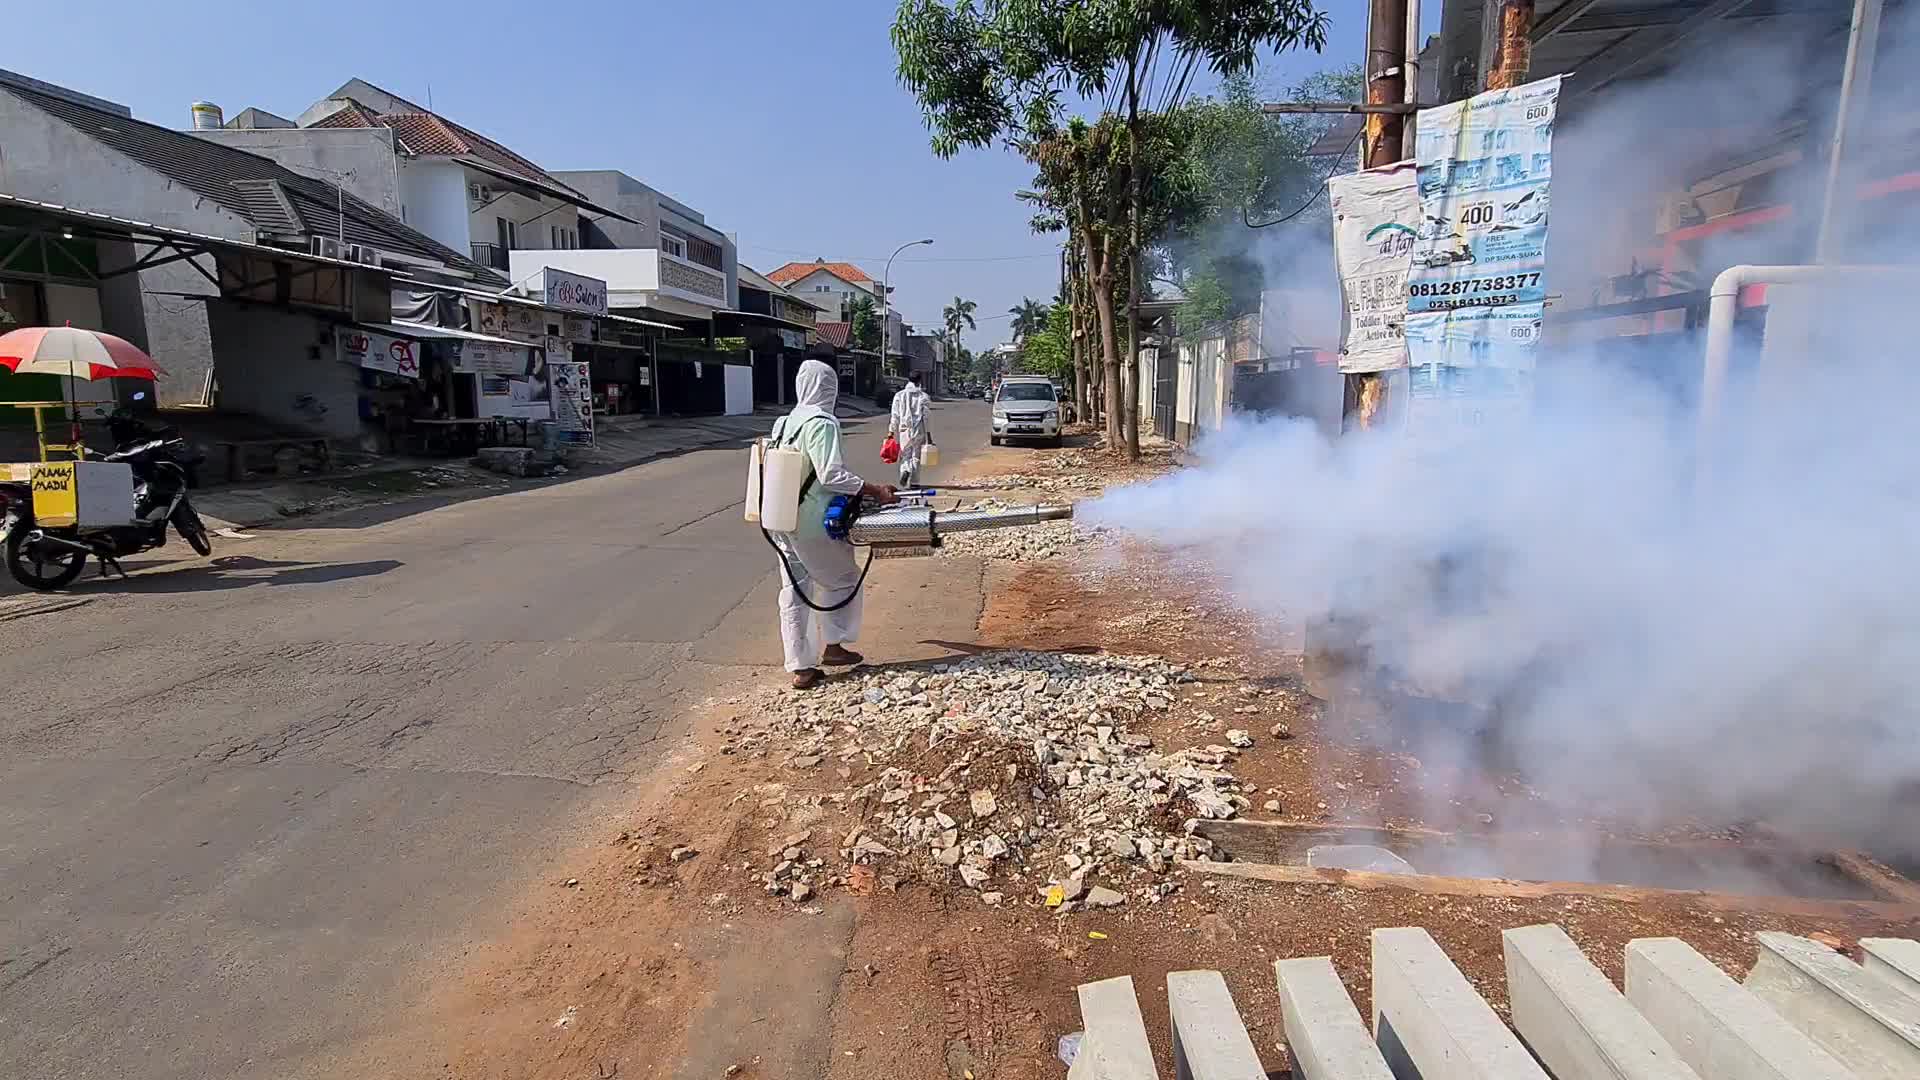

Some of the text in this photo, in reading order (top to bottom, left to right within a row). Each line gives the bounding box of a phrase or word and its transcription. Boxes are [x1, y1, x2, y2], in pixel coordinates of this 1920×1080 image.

[1526, 106, 1548, 120] 600
[1460, 205, 1493, 225] 400
[1486, 235, 1506, 243] FREE
[1410, 272, 1541, 297] 081287738377
[1429, 294, 1518, 310] 02518413573
[1511, 327, 1532, 338] 600
[33, 480, 68, 491] MADU
